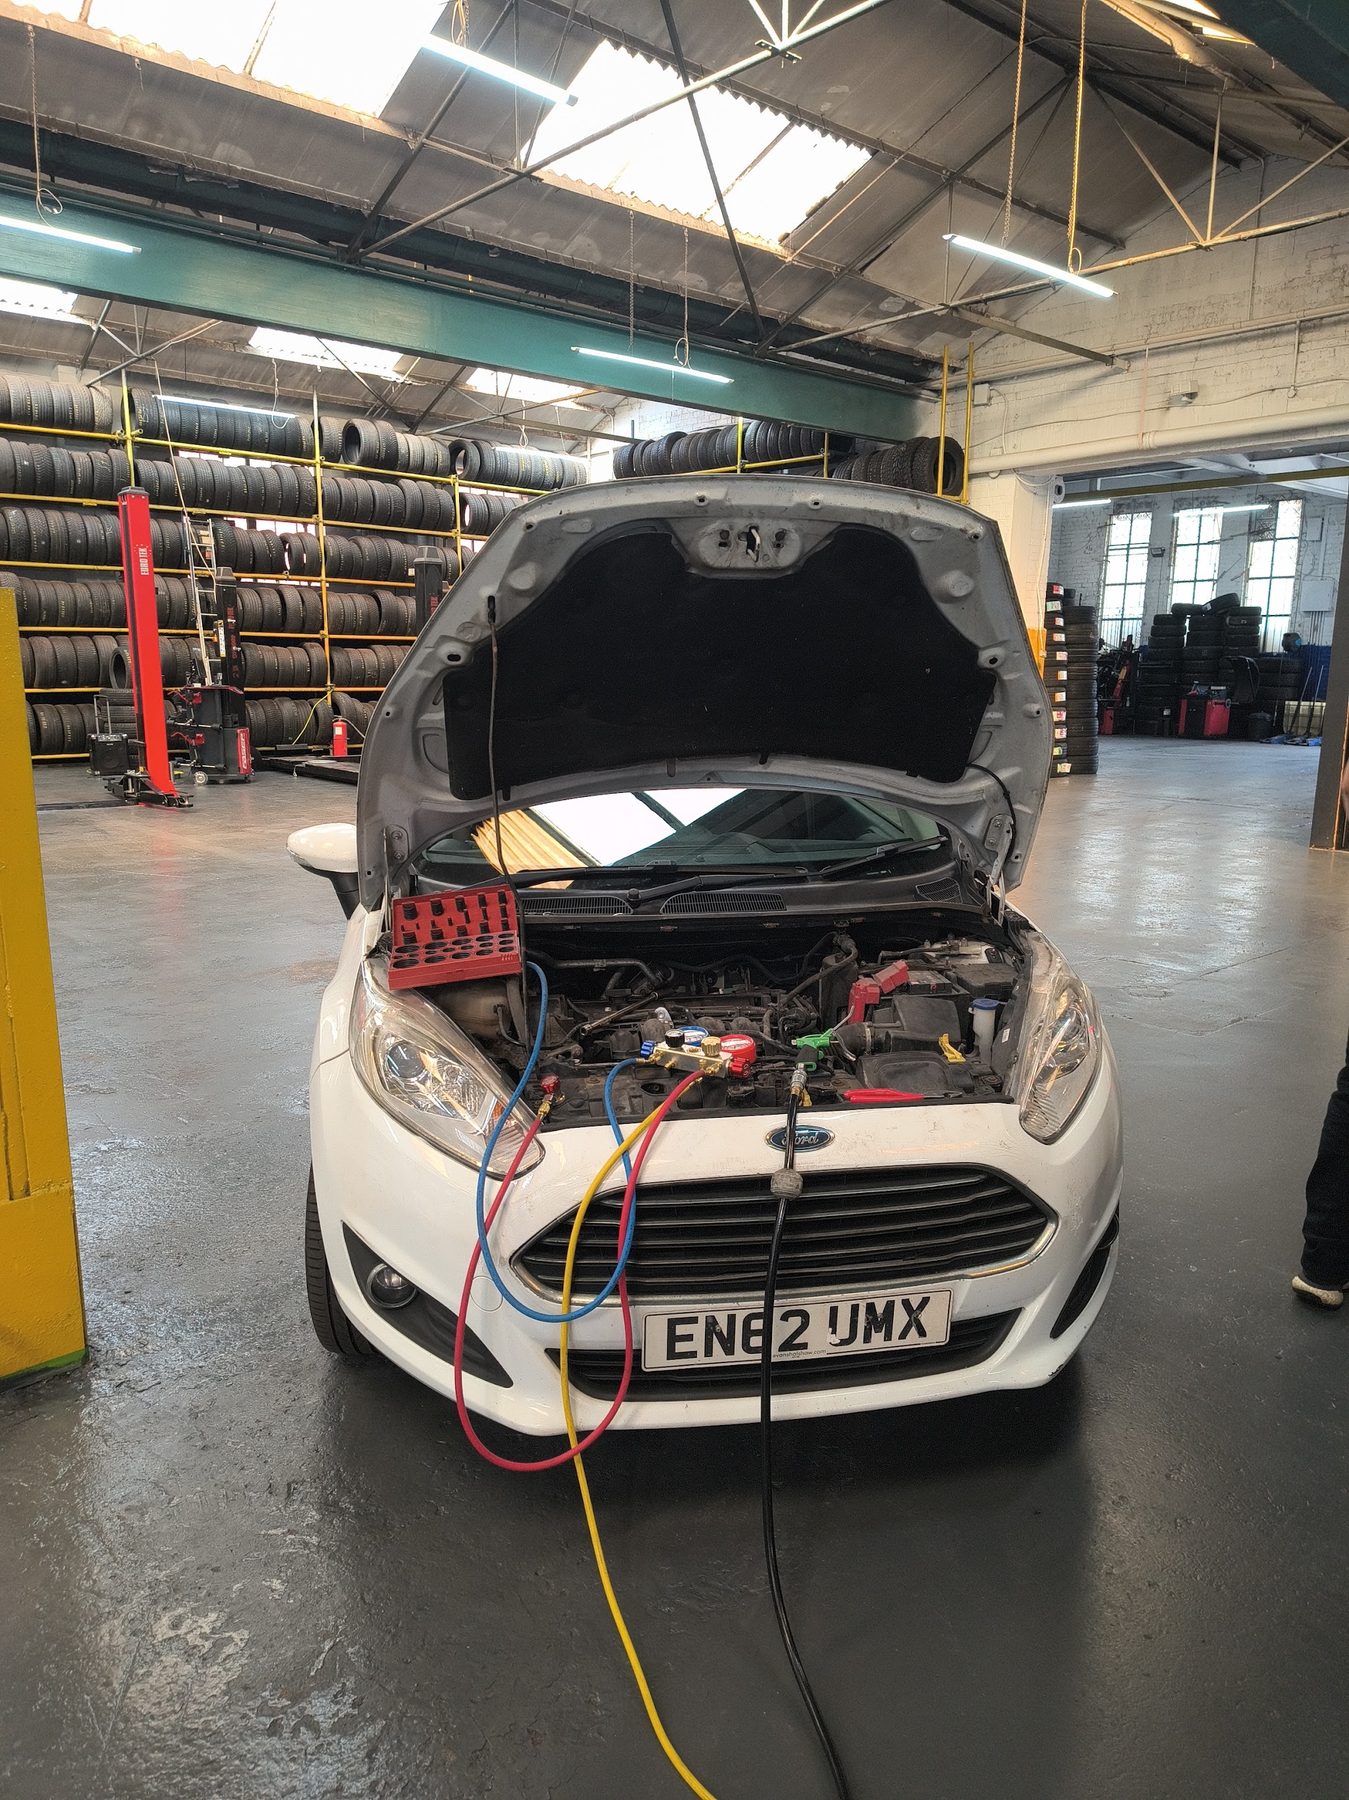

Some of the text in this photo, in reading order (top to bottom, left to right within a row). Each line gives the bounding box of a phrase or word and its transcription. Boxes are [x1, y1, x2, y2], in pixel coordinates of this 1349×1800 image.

[138, 548, 149, 575] EURO TEK
[666, 1296, 931, 1361] EN62 UMX
